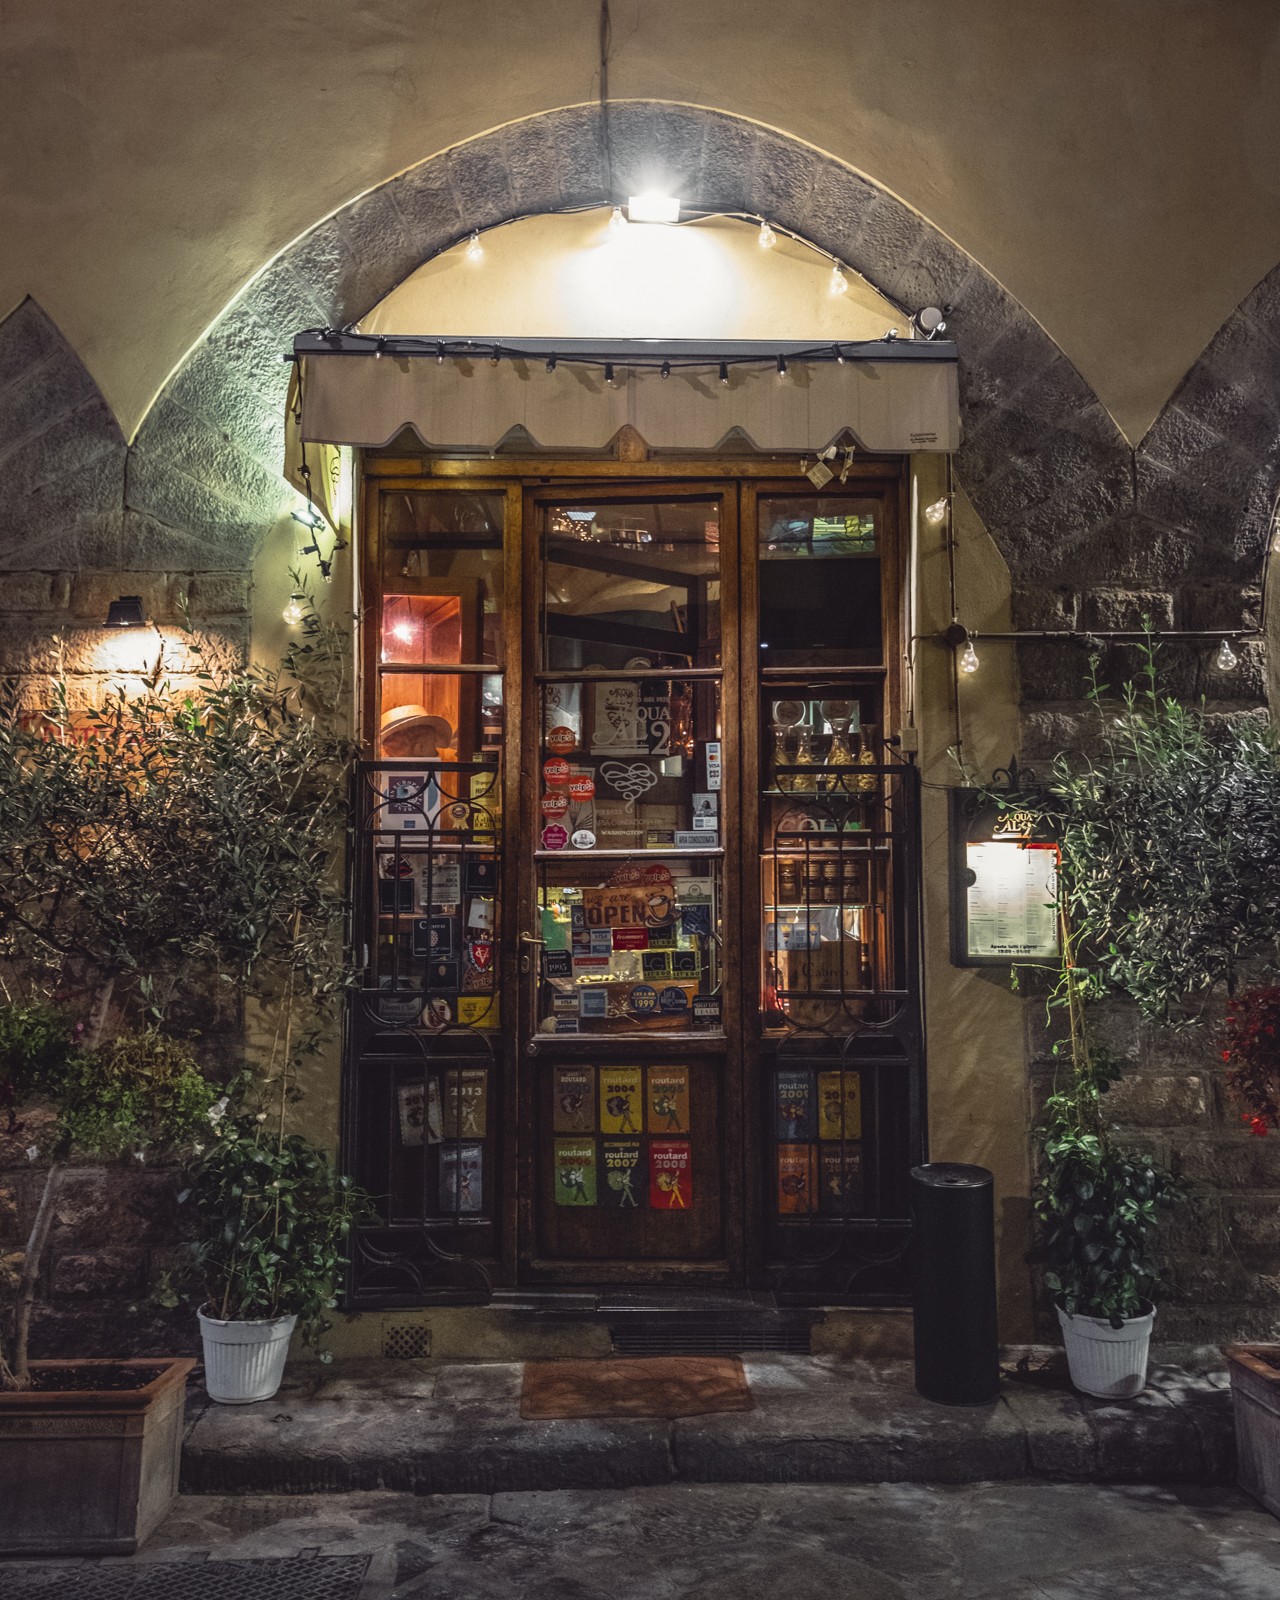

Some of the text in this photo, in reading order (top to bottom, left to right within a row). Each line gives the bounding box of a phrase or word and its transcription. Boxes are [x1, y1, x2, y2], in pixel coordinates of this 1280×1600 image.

[550, 734, 567, 743] yelp
[650, 720, 671, 756] 2
[545, 766, 561, 774] yelp
[569, 783, 586, 791] yelp
[542, 800, 559, 808] yelp
[993, 820, 1022, 833] AL
[587, 902, 646, 925] OPEN
[634, 1000, 655, 1008] 1999
[603, 1076, 638, 1084] routard
[651, 1076, 685, 1084] routard
[607, 1085, 636, 1093] 2004
[778, 1082, 809, 1090] routar
[824, 1091, 856, 1100] 200
[558, 1149, 592, 1157] routard
[604, 1150, 639, 1159] routard
[653, 1152, 688, 1160] routard
[606, 1159, 638, 1168] 2007
[825, 1155, 859, 1164] rouard
[655, 1160, 687, 1169] 2008
